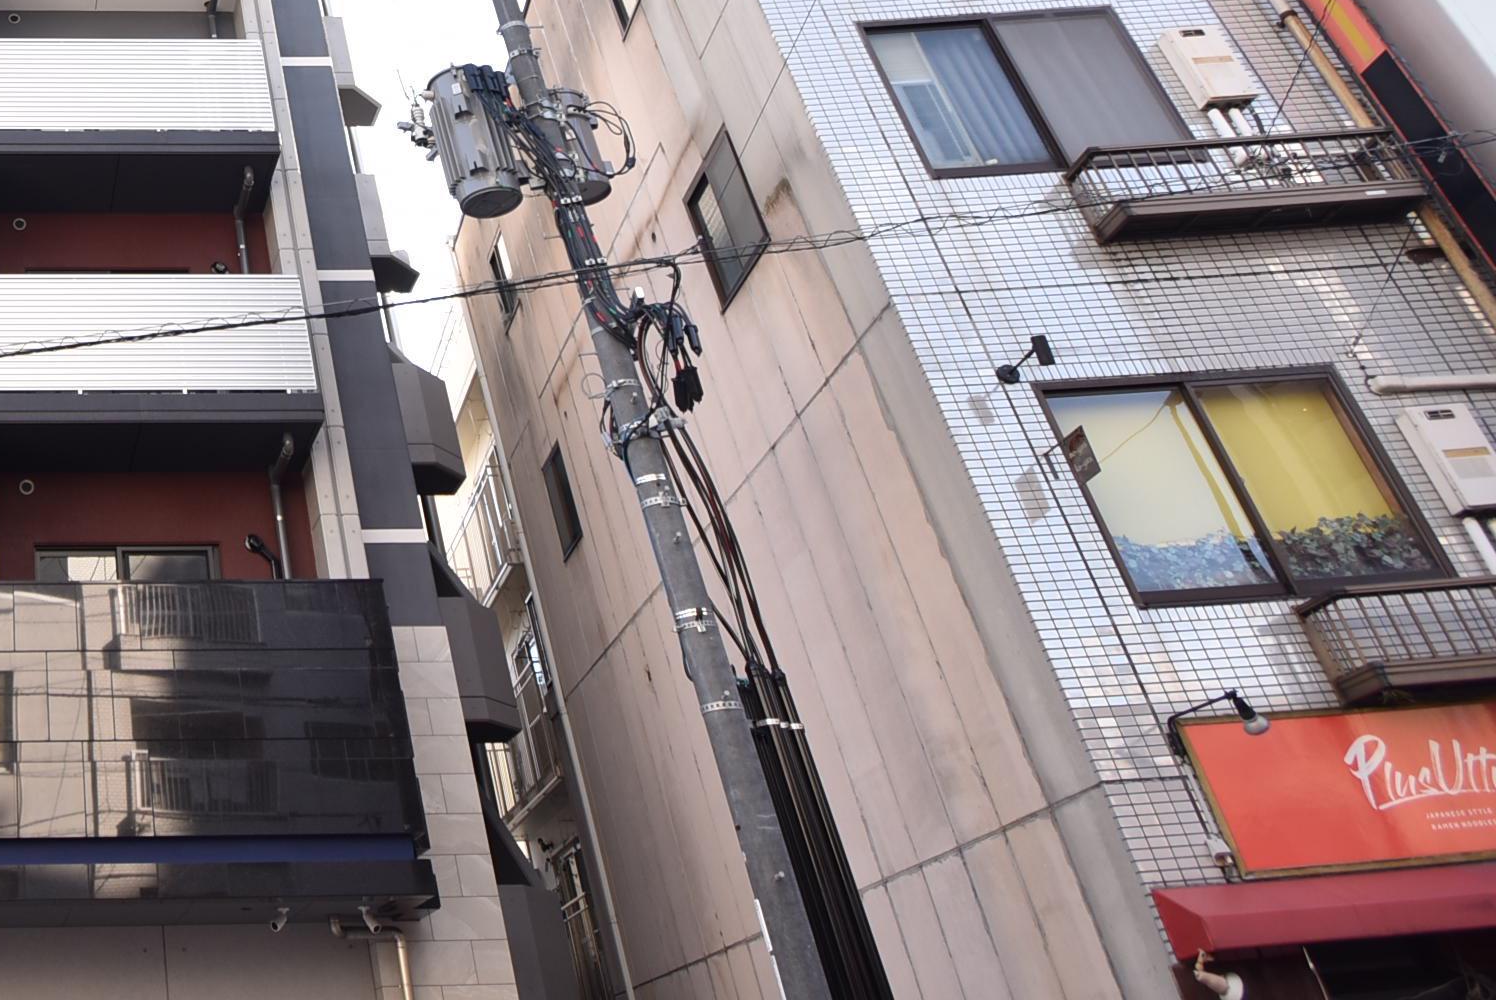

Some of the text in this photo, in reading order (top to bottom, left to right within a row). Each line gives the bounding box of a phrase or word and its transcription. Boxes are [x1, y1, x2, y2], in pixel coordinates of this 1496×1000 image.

[1426, 807, 1493, 819] JAPANESE STYLE
[1431, 822, 1460, 831] RAMEN
